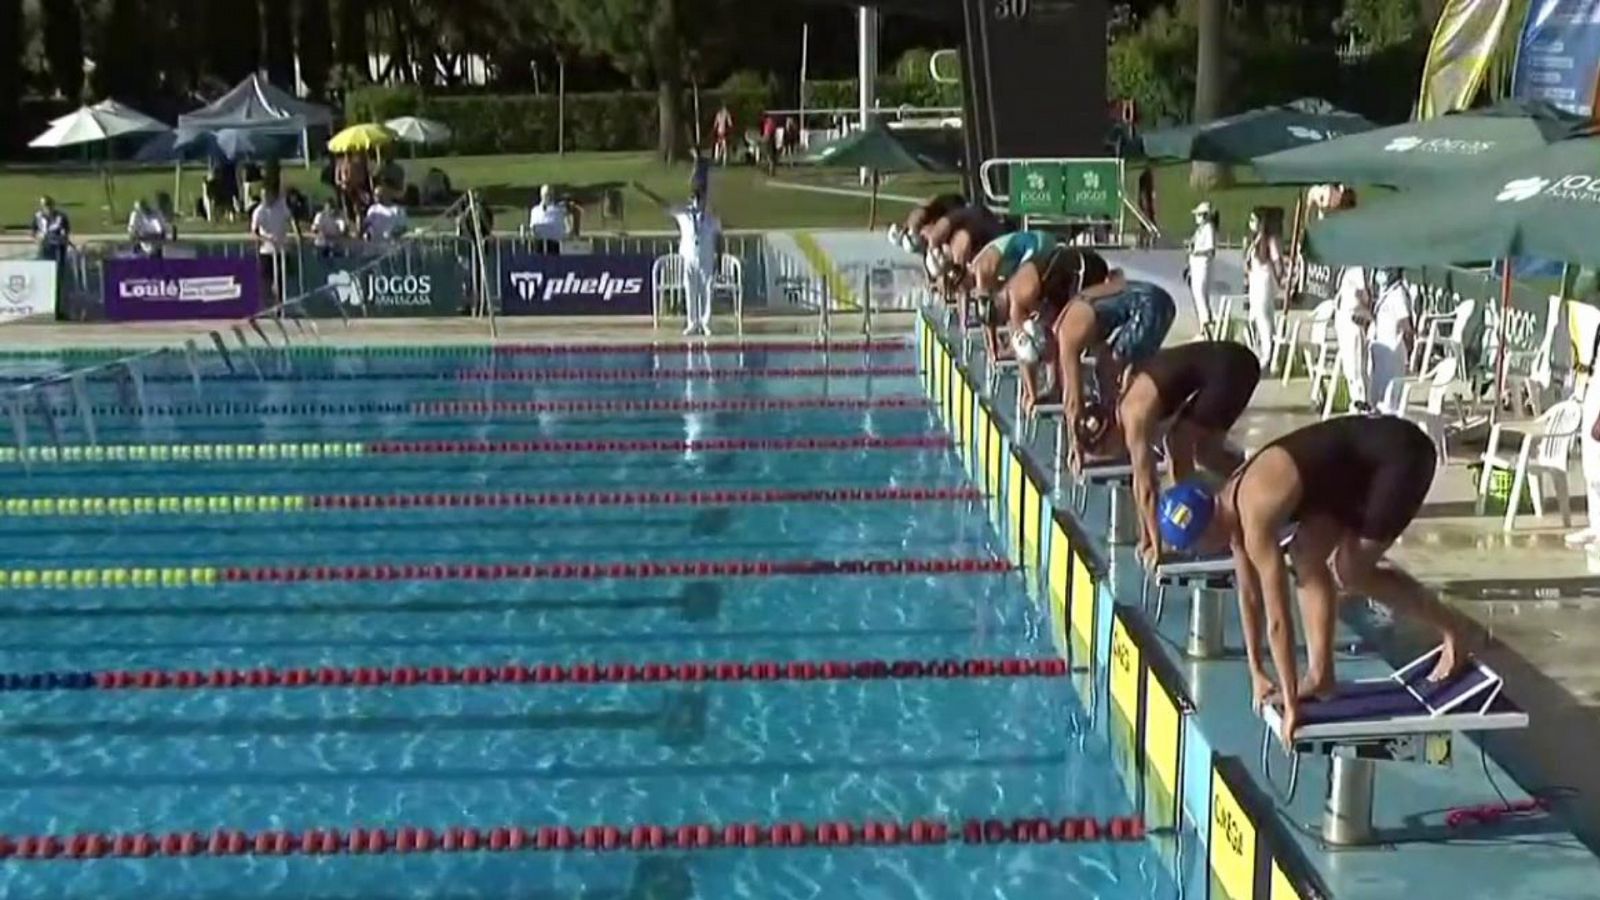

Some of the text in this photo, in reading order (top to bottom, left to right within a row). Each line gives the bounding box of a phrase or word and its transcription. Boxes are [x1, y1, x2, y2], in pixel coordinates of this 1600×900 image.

[119, 279, 178, 298] Loulé
[368, 274, 431, 301] JOGOS
[542, 271, 643, 301] phelps
